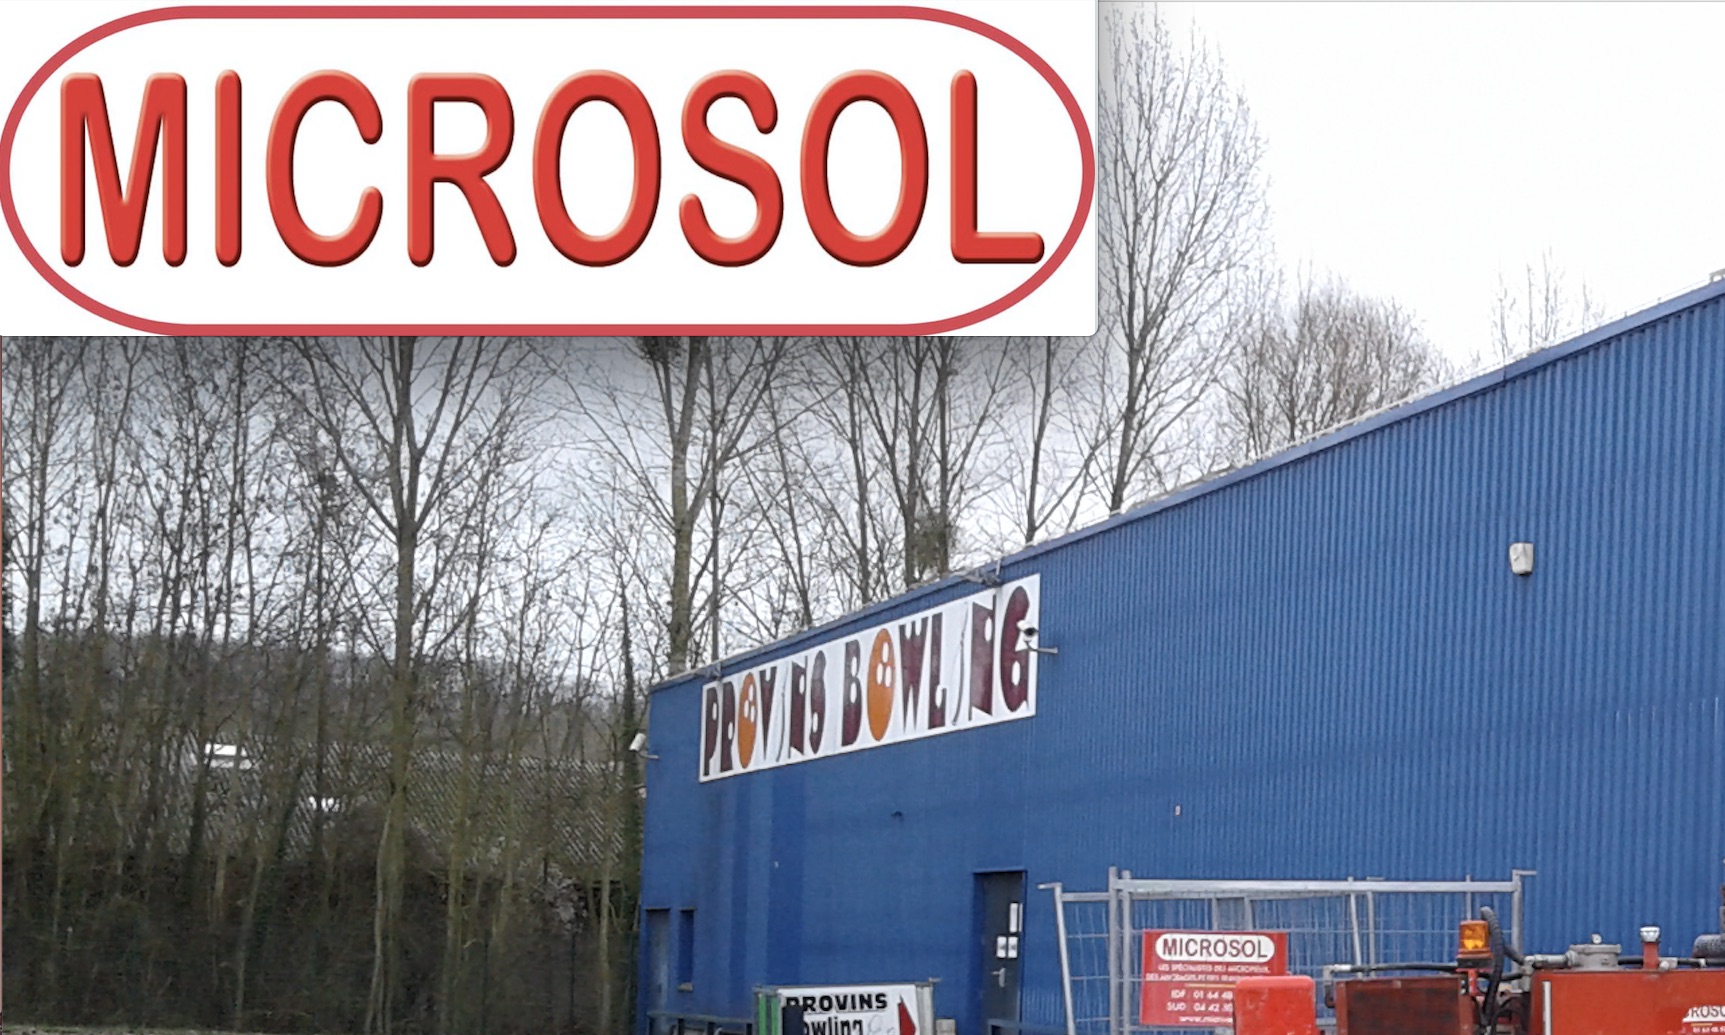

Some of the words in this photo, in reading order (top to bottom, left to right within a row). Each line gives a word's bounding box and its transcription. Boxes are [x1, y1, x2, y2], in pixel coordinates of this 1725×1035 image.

[703, 650, 826, 777] PROVINS
[840, 585, 1030, 747] BOWLING
[1163, 938, 1267, 958] MICROSOL
[785, 993, 887, 1011] PROVINS
